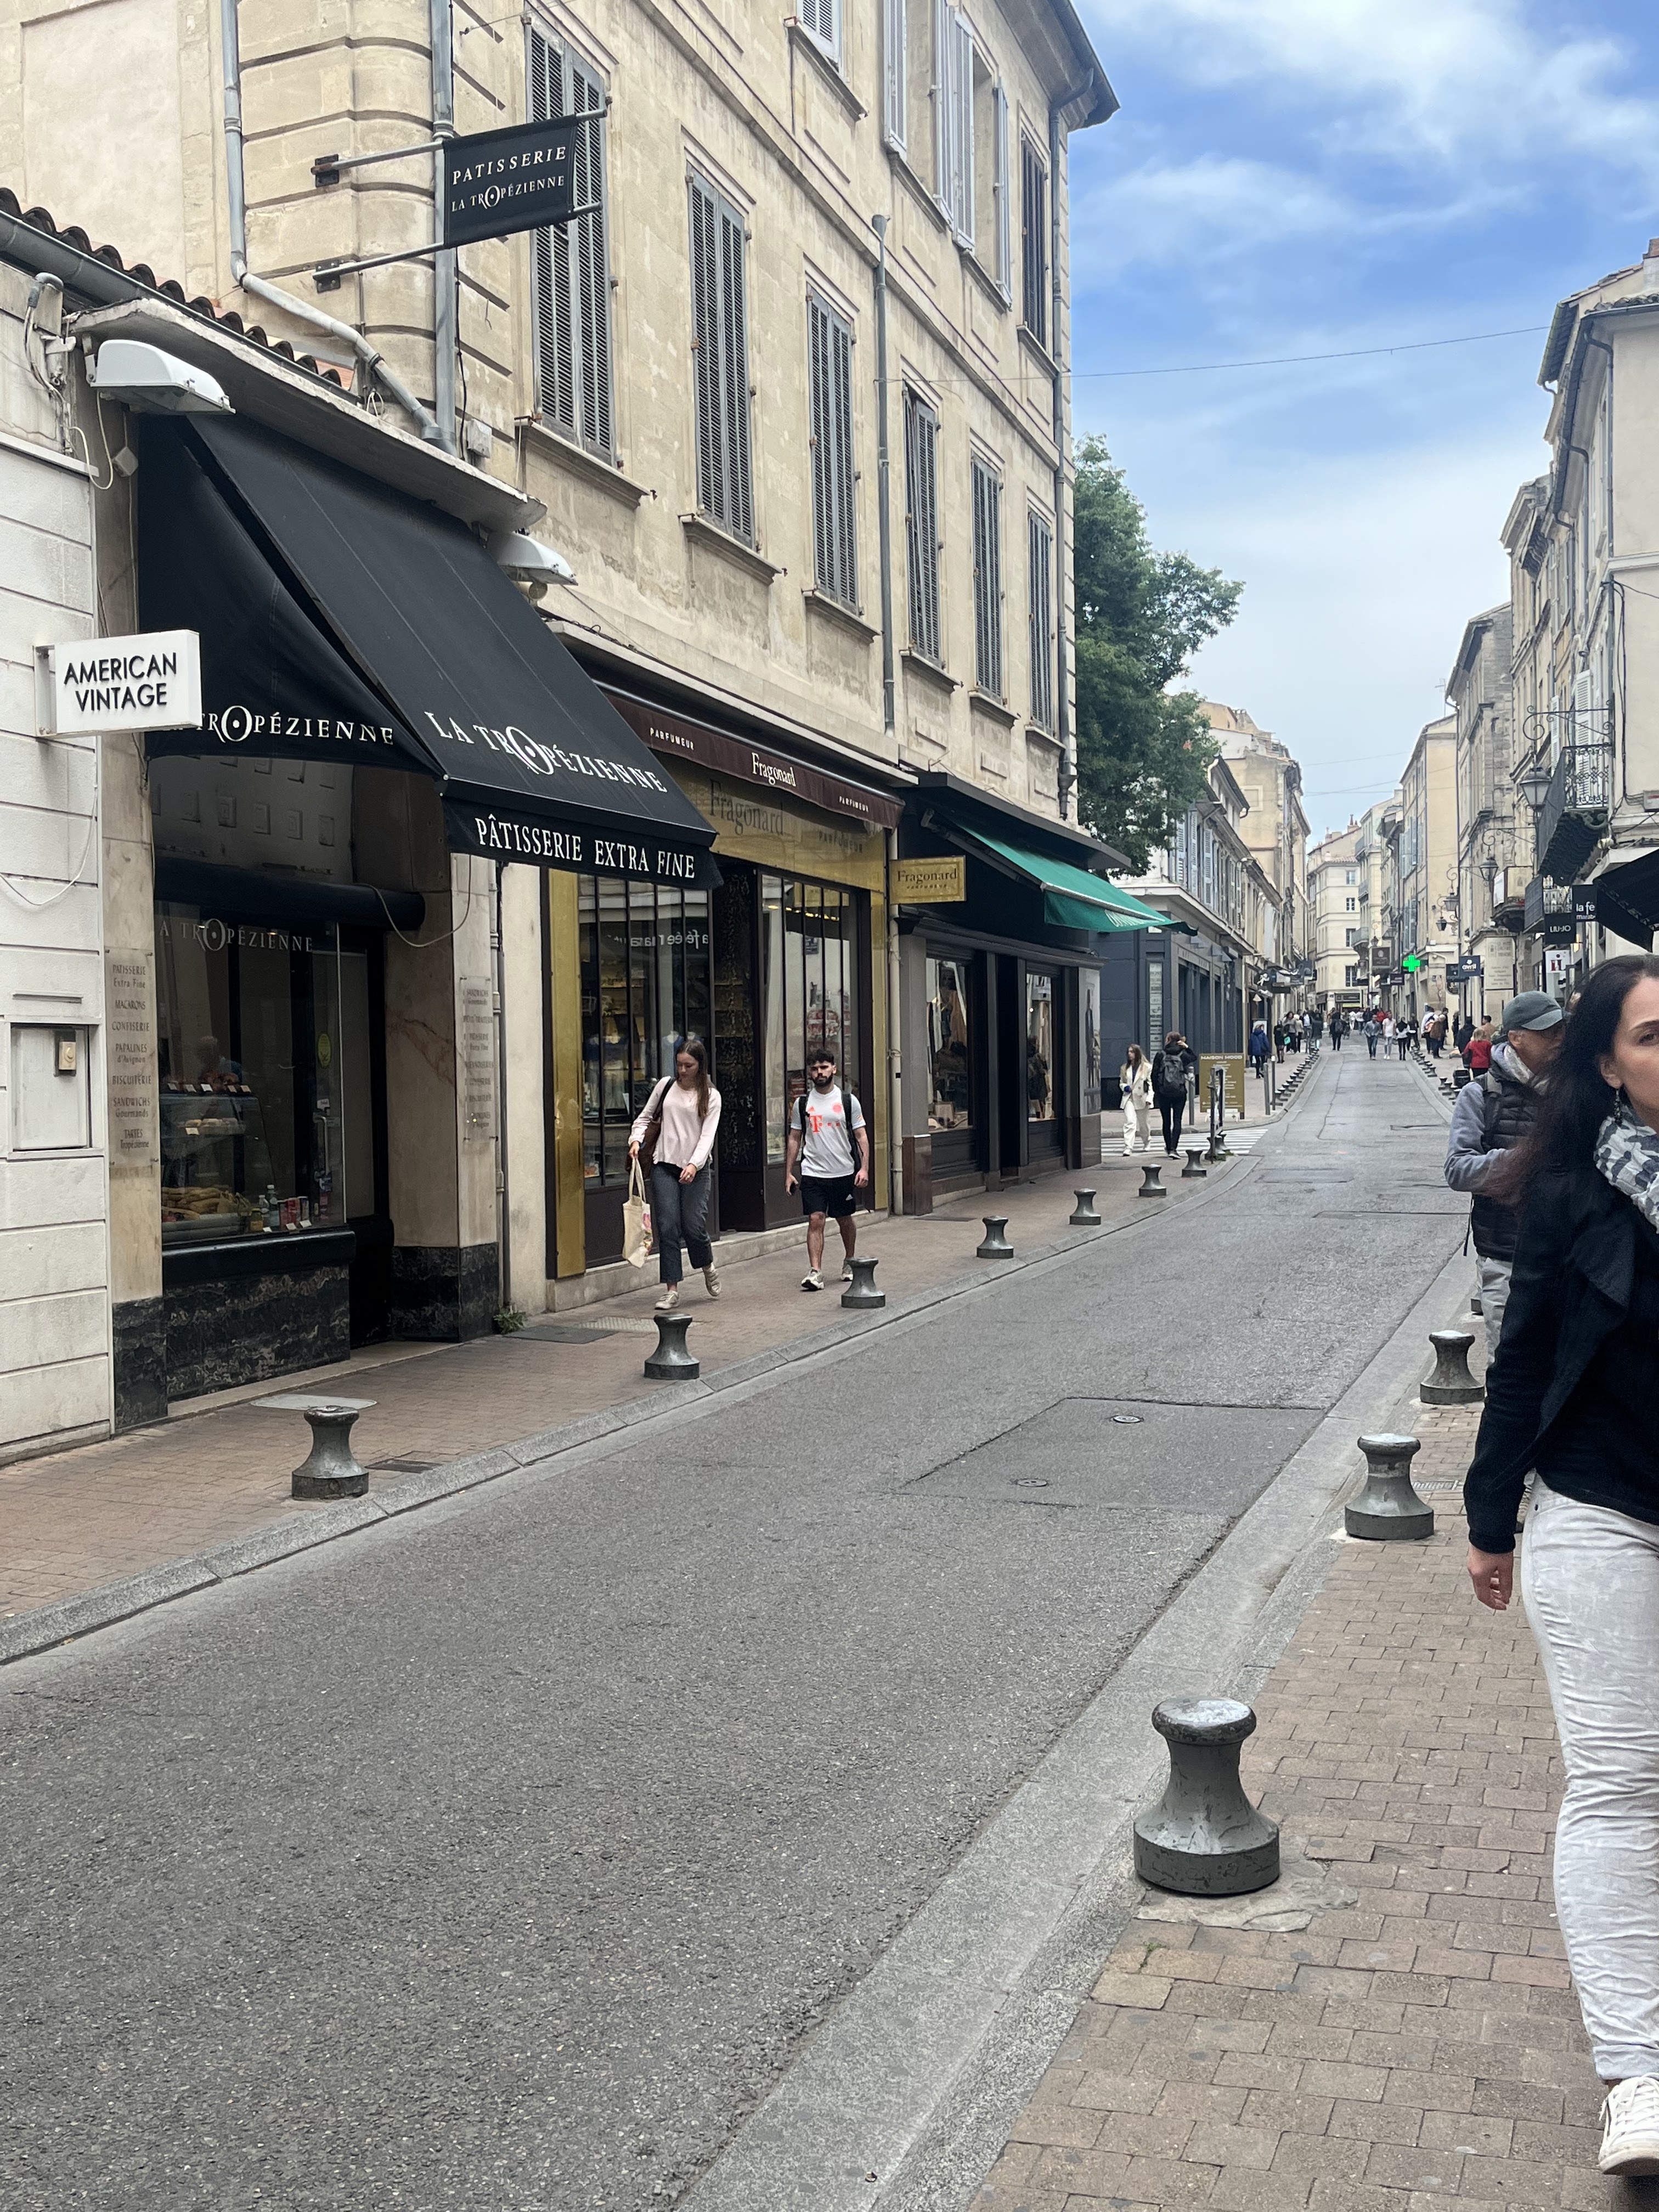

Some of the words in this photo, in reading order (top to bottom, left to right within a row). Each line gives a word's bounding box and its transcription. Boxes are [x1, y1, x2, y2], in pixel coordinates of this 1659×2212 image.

[453, 146, 566, 185] PATISSERIE
[452, 199, 465, 212] LA
[470, 176, 565, 210] TROPÉZIENNE
[64, 652, 177, 685] AMERICAN
[75, 683, 167, 712] VINTAGE
[424, 712, 474, 744] LA
[473, 725, 667, 792] TROPÉZIENNE
[650, 727, 695, 751] PARFUMEUR
[752, 752, 797, 787] Fragonard
[709, 778, 785, 836] Fragonard
[839, 795, 869, 812] PARFUMEUR
[475, 814, 583, 861] PÂTISSERIE
[595, 840, 649, 872] EXTRA
[657, 851, 695, 878] FINE
[819, 831, 863, 854] PARFUMEUR
[898, 868, 957, 884] Fragonard
[180, 918, 313, 952] TROPÉZIENNE
[112, 964, 146, 975] PATISSERIE
[114, 977, 130, 988] Extra
[112, 1021, 150, 1031] CONFISERIE
[112, 1075, 151, 1085] BISCUITERIE
